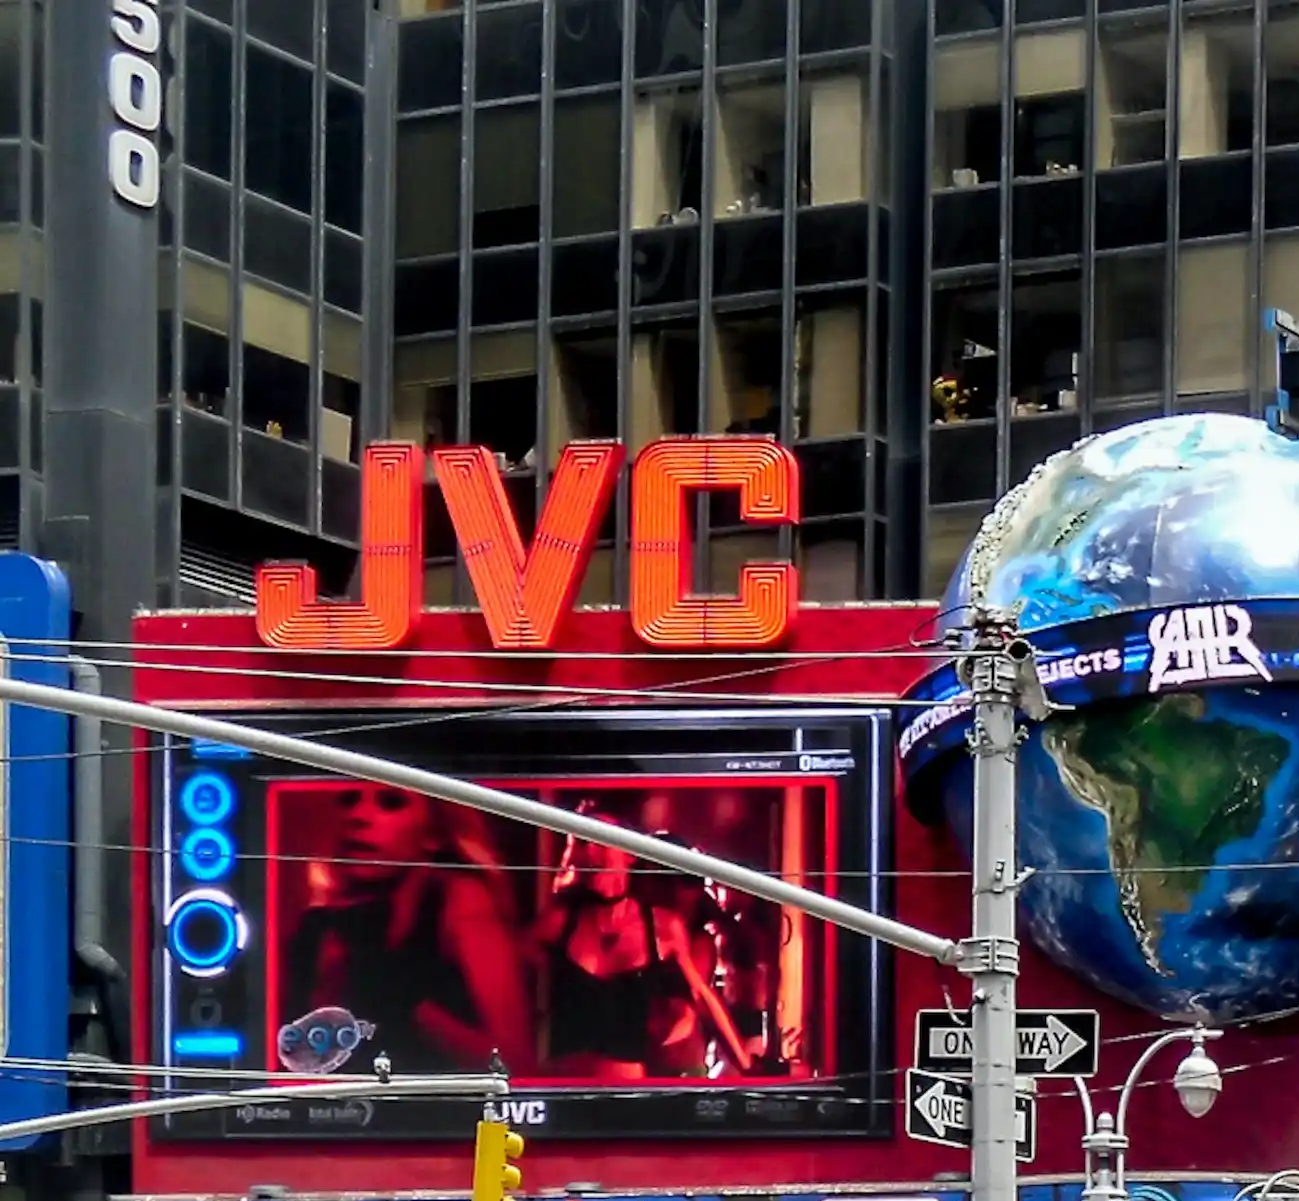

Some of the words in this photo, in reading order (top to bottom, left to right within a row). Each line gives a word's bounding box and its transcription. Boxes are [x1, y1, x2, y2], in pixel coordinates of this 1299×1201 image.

[255, 440, 802, 650] JVC
[1036, 648, 1122, 685] EJECTS
[944, 1031, 973, 1054] ON
[1019, 1032, 1069, 1054] WAY
[928, 1095, 964, 1124] ONE
